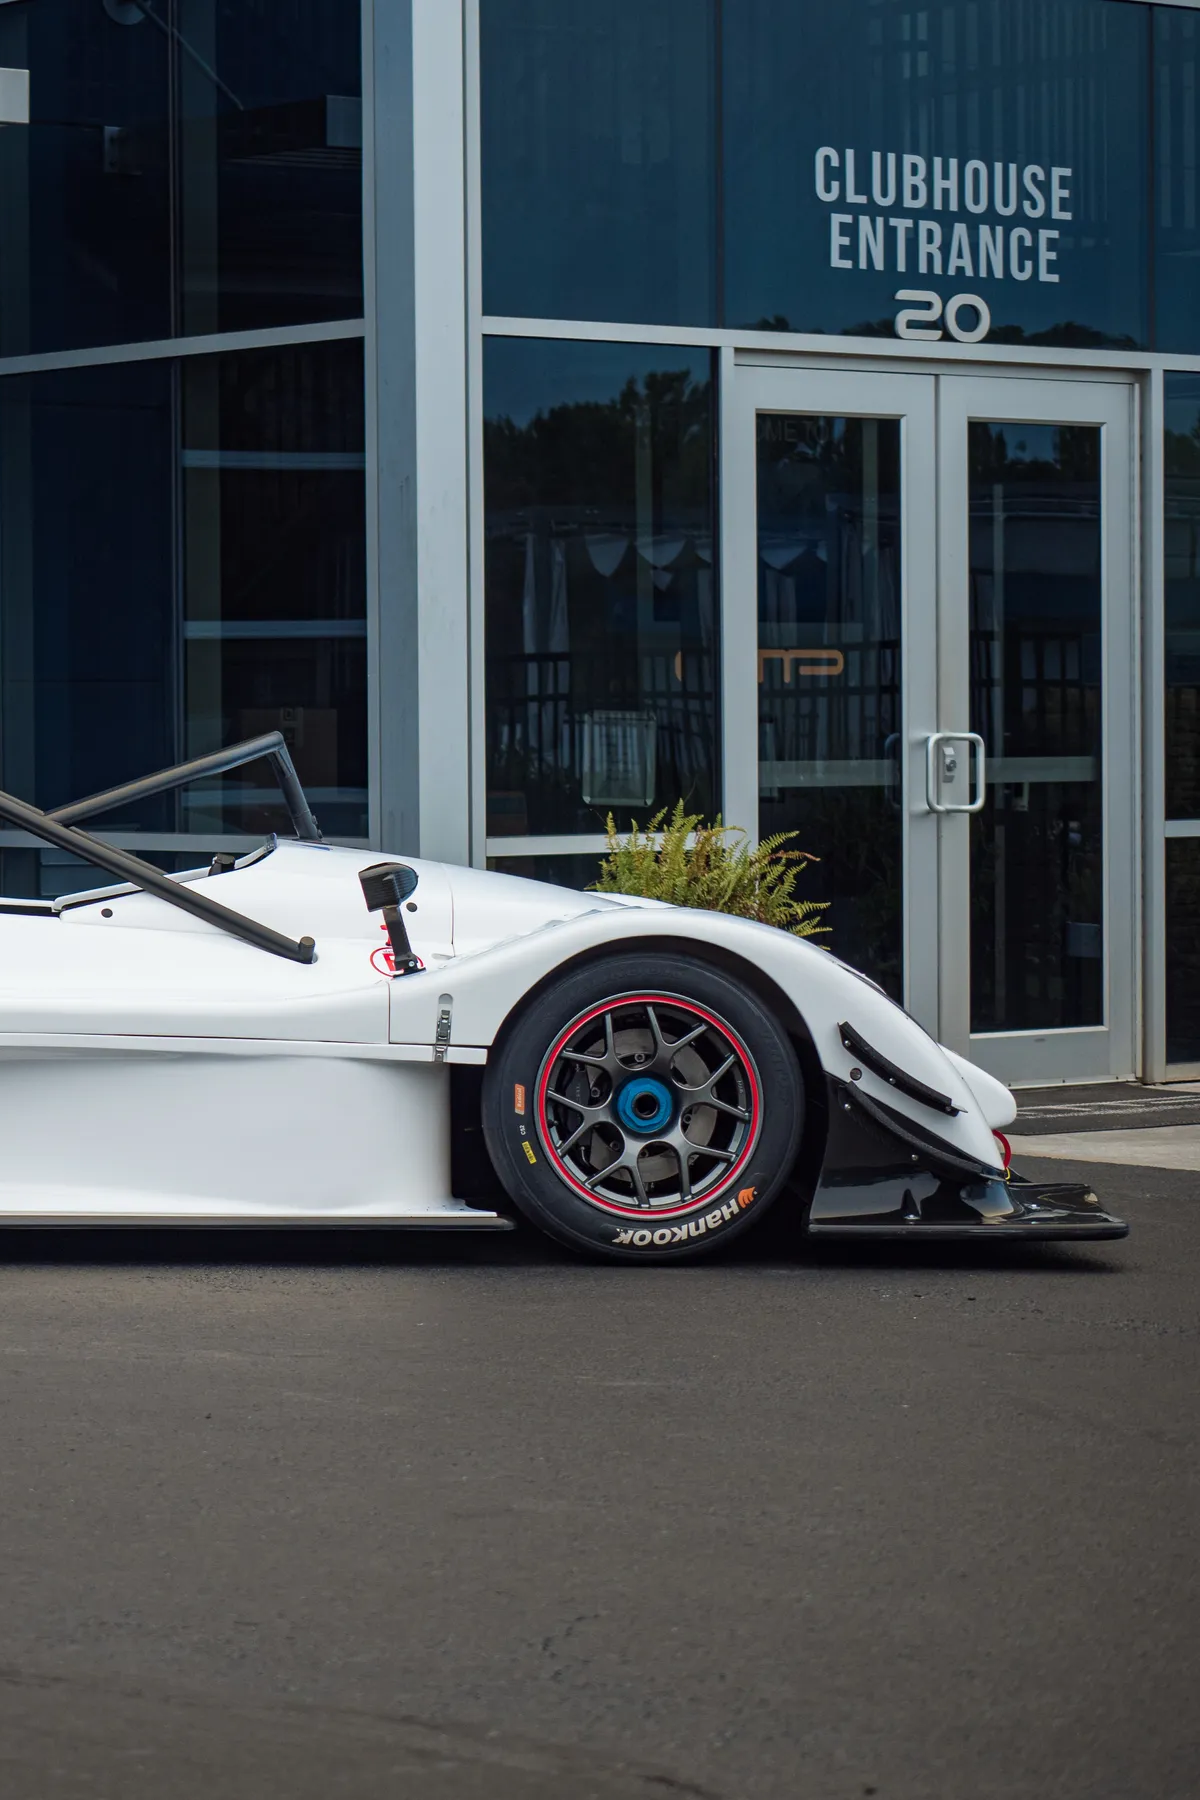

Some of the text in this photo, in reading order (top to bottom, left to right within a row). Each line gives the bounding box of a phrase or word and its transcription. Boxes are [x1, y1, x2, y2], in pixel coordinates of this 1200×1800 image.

[815, 146, 1072, 221] CLUBHOUSE
[830, 213, 1060, 283] ENTRANCE
[894, 289, 991, 343] 20
